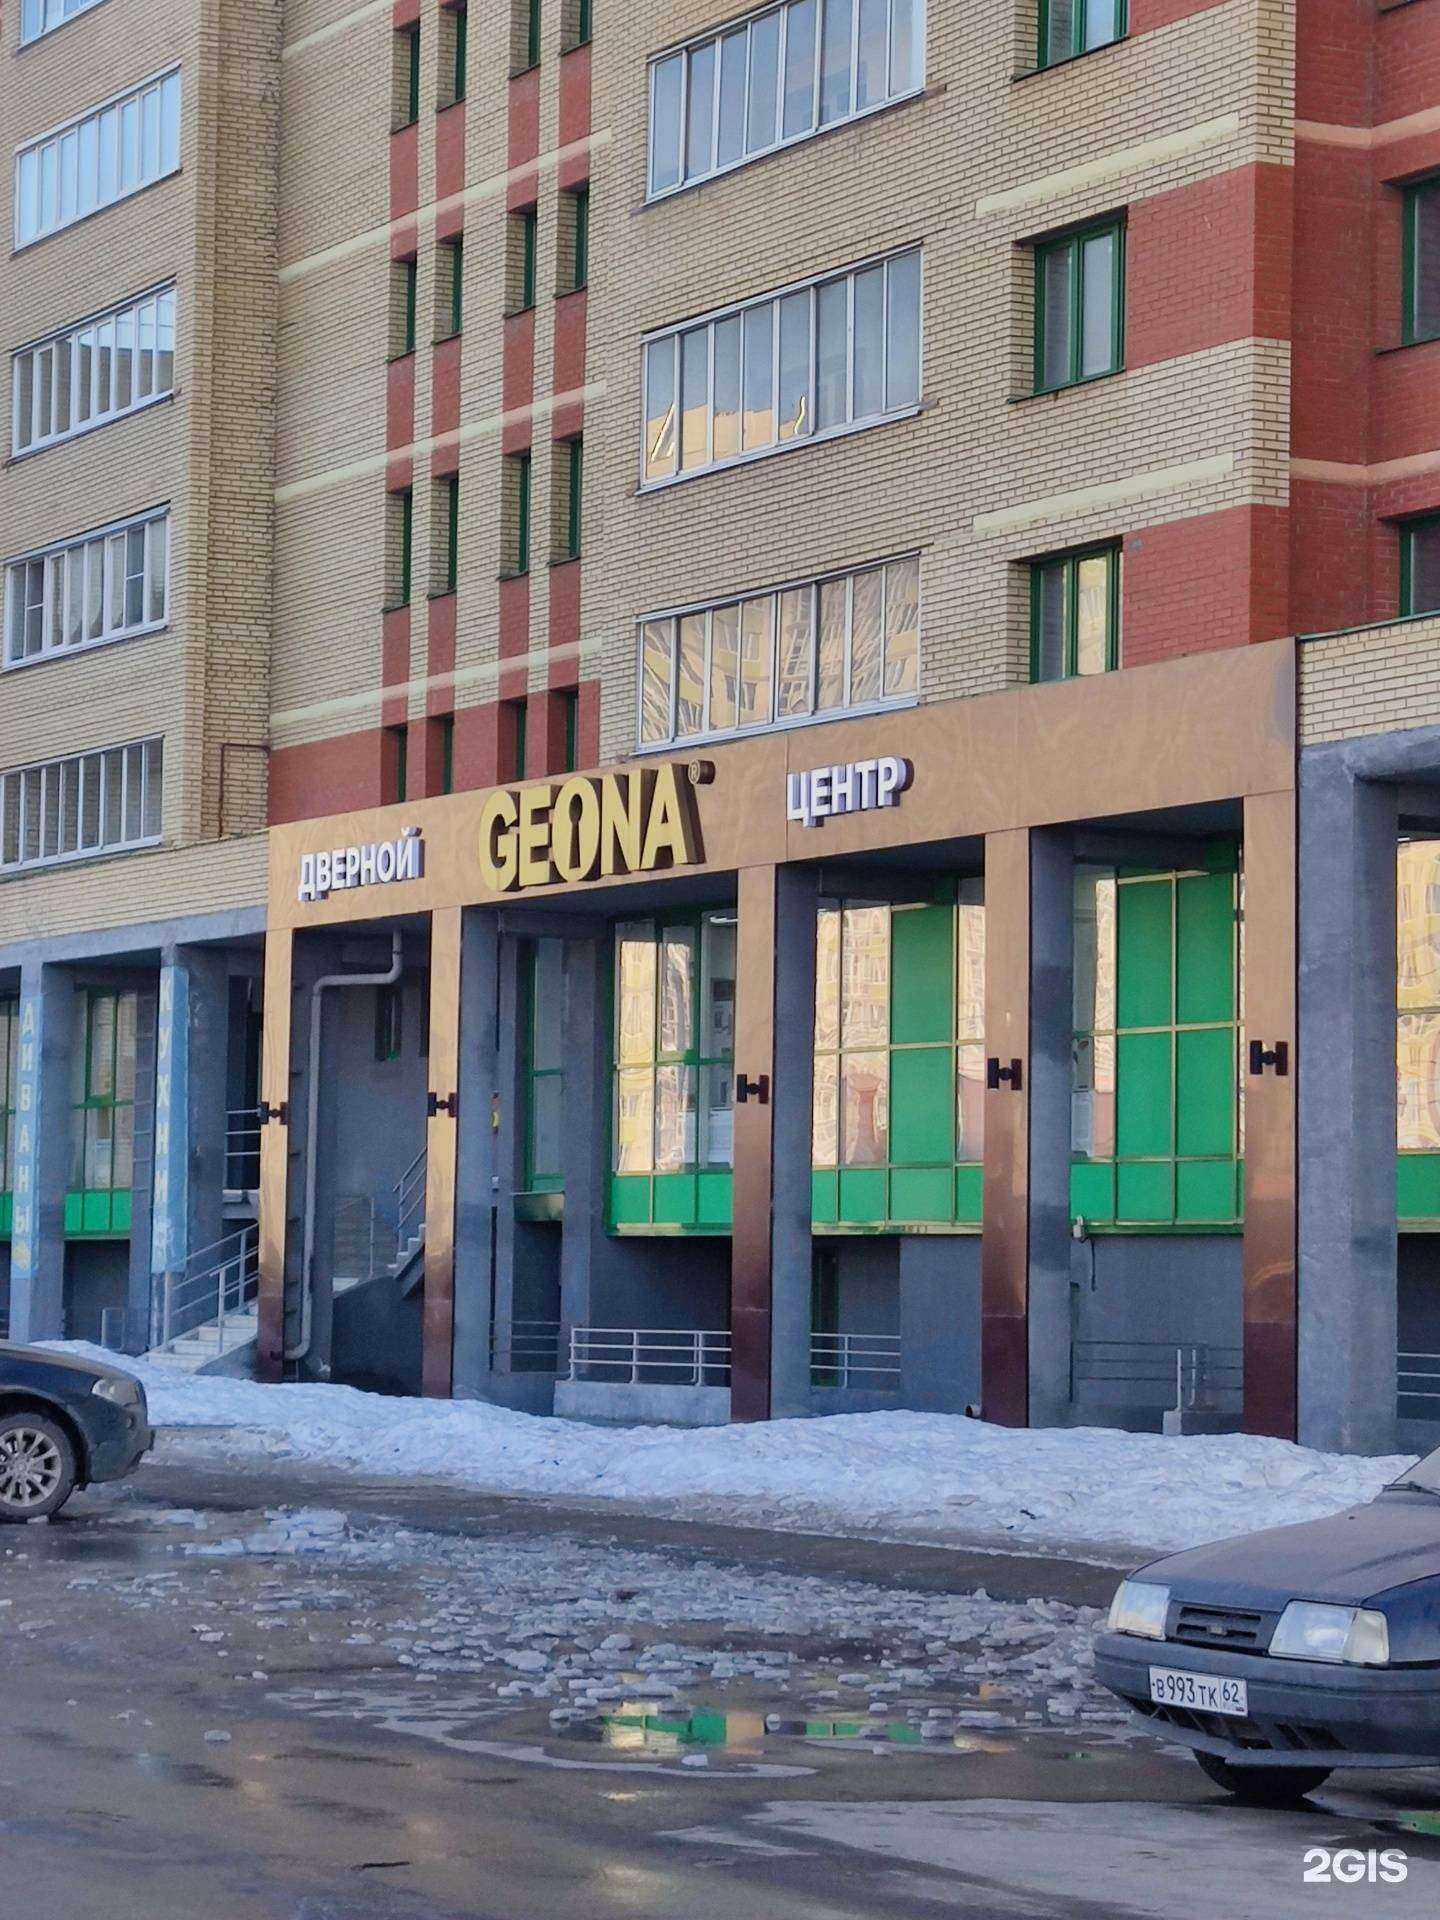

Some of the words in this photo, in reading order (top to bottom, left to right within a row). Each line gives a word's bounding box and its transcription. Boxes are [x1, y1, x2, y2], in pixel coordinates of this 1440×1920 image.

[298, 826, 419, 901] ДВЕРНОЙ
[787, 756, 905, 827] ЦЕНТР
[16, 1000, 33, 1234] ДИВАНЫ
[155, 973, 172, 1203] КУХНИ
